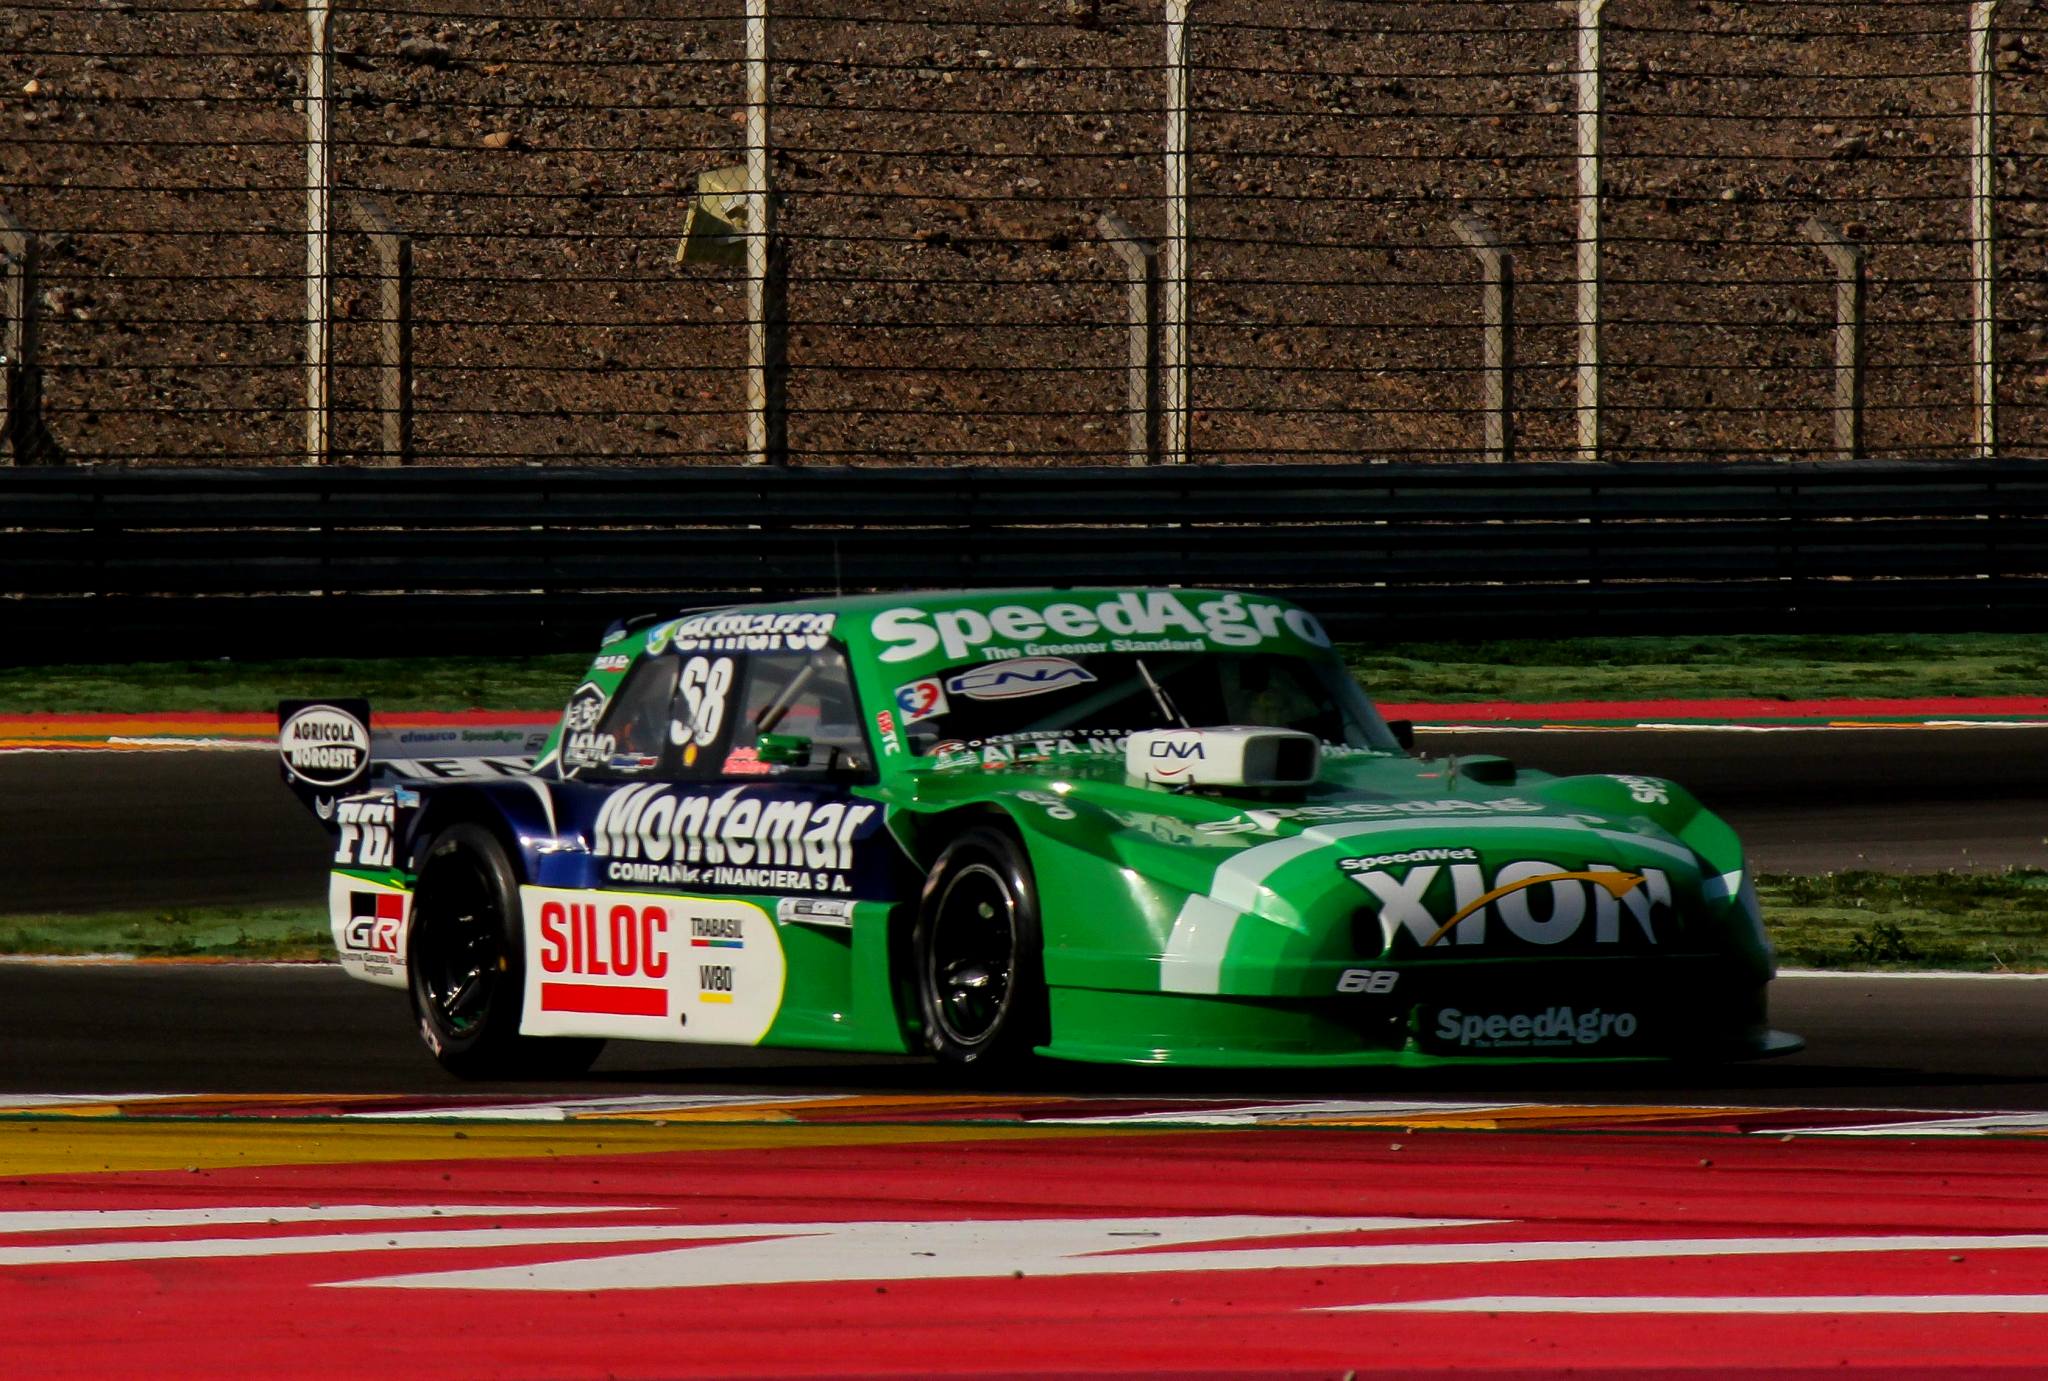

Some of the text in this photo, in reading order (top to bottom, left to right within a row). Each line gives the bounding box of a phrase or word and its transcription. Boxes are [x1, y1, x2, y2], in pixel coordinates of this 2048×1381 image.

[871, 592, 1331, 663] SpeedAgro
[982, 638, 1206, 660] The Greener Standard
[293, 721, 355, 741] AGRICOLA
[292, 747, 357, 769] NOROESTE
[1151, 740, 1205, 760] CNA
[592, 782, 877, 869] Montemar
[1341, 848, 1478, 871] SpeedWet
[1351, 860, 1672, 948] XION
[345, 916, 402, 951] GR
[540, 901, 668, 979] SILOC
[690, 917, 744, 939] TRABASIL
[699, 965, 733, 992] W80
[1336, 969, 1400, 994] 68
[1435, 1005, 1638, 1046] SpeedAgro
